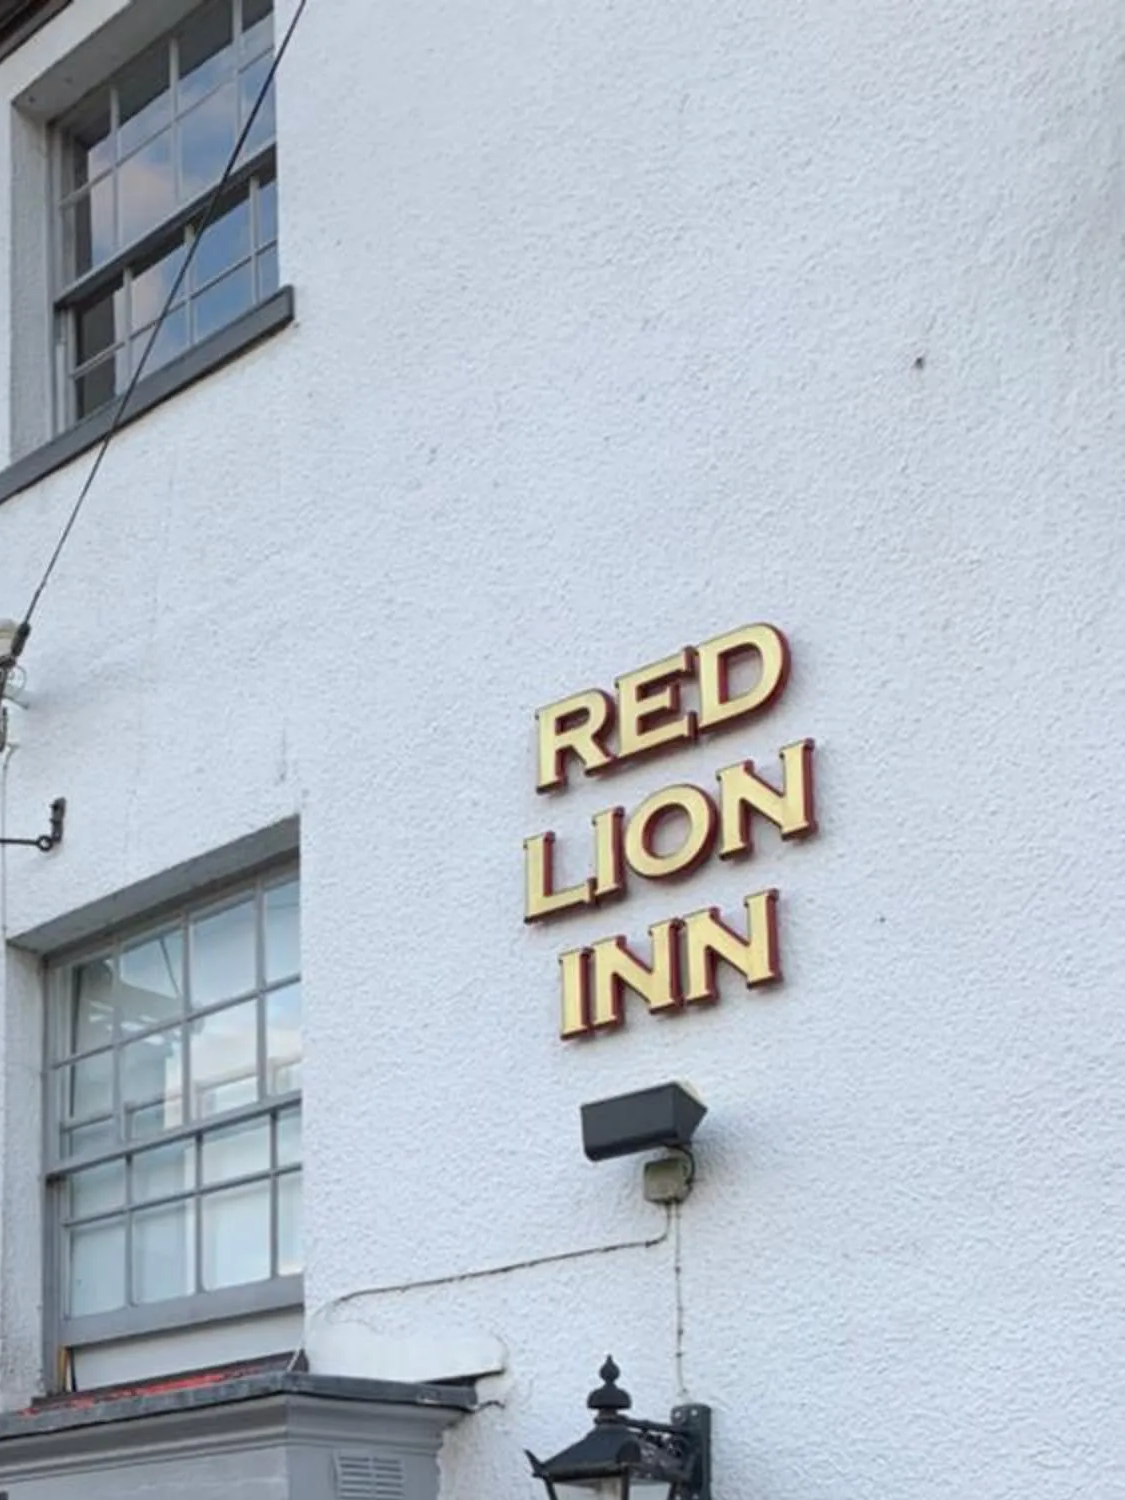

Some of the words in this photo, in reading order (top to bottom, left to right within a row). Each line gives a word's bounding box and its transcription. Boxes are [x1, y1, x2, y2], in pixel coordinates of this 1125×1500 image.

[535, 621, 792, 796] RED
[523, 737, 817, 925] LION
[559, 887, 781, 1042] INN
